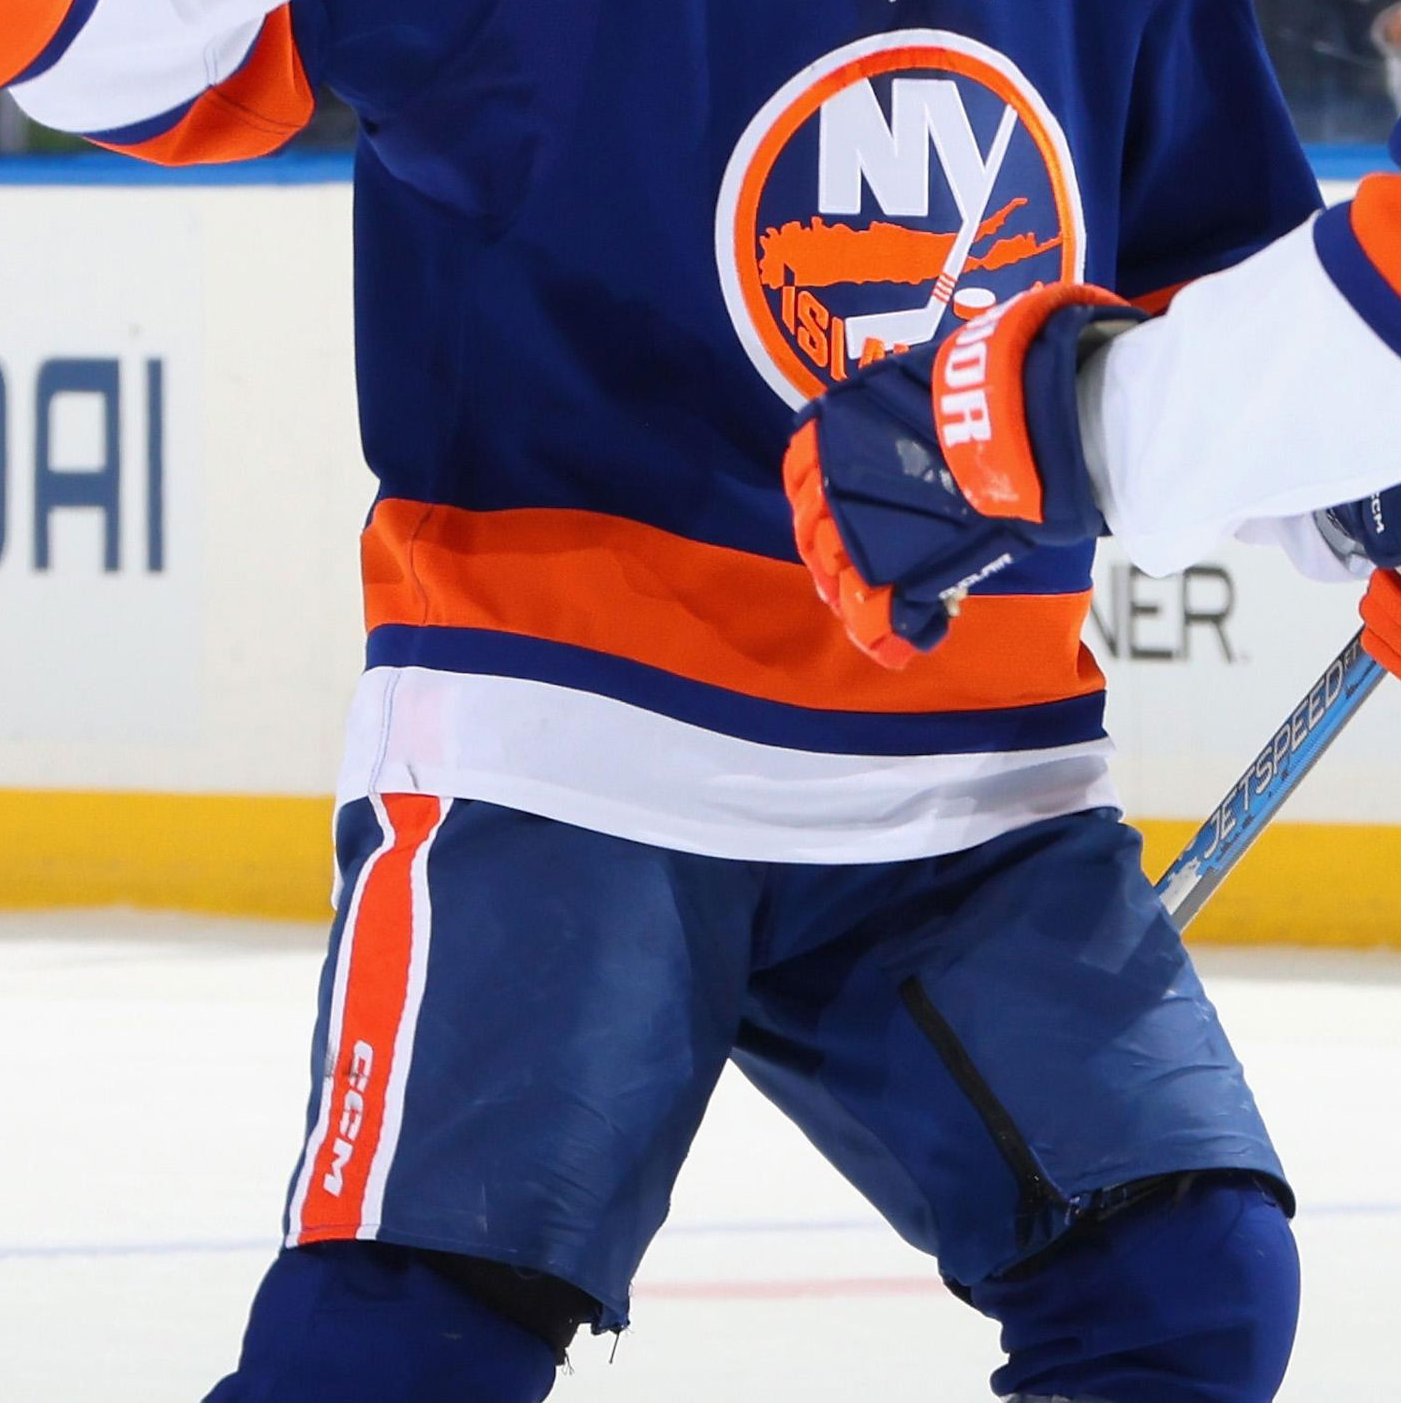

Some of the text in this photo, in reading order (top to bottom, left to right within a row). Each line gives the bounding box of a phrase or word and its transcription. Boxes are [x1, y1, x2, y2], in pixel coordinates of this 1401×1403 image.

[818, 78, 1019, 220] NY
[1203, 657, 1343, 859] JETSPEED
[322, 1039, 375, 1197] CCM
